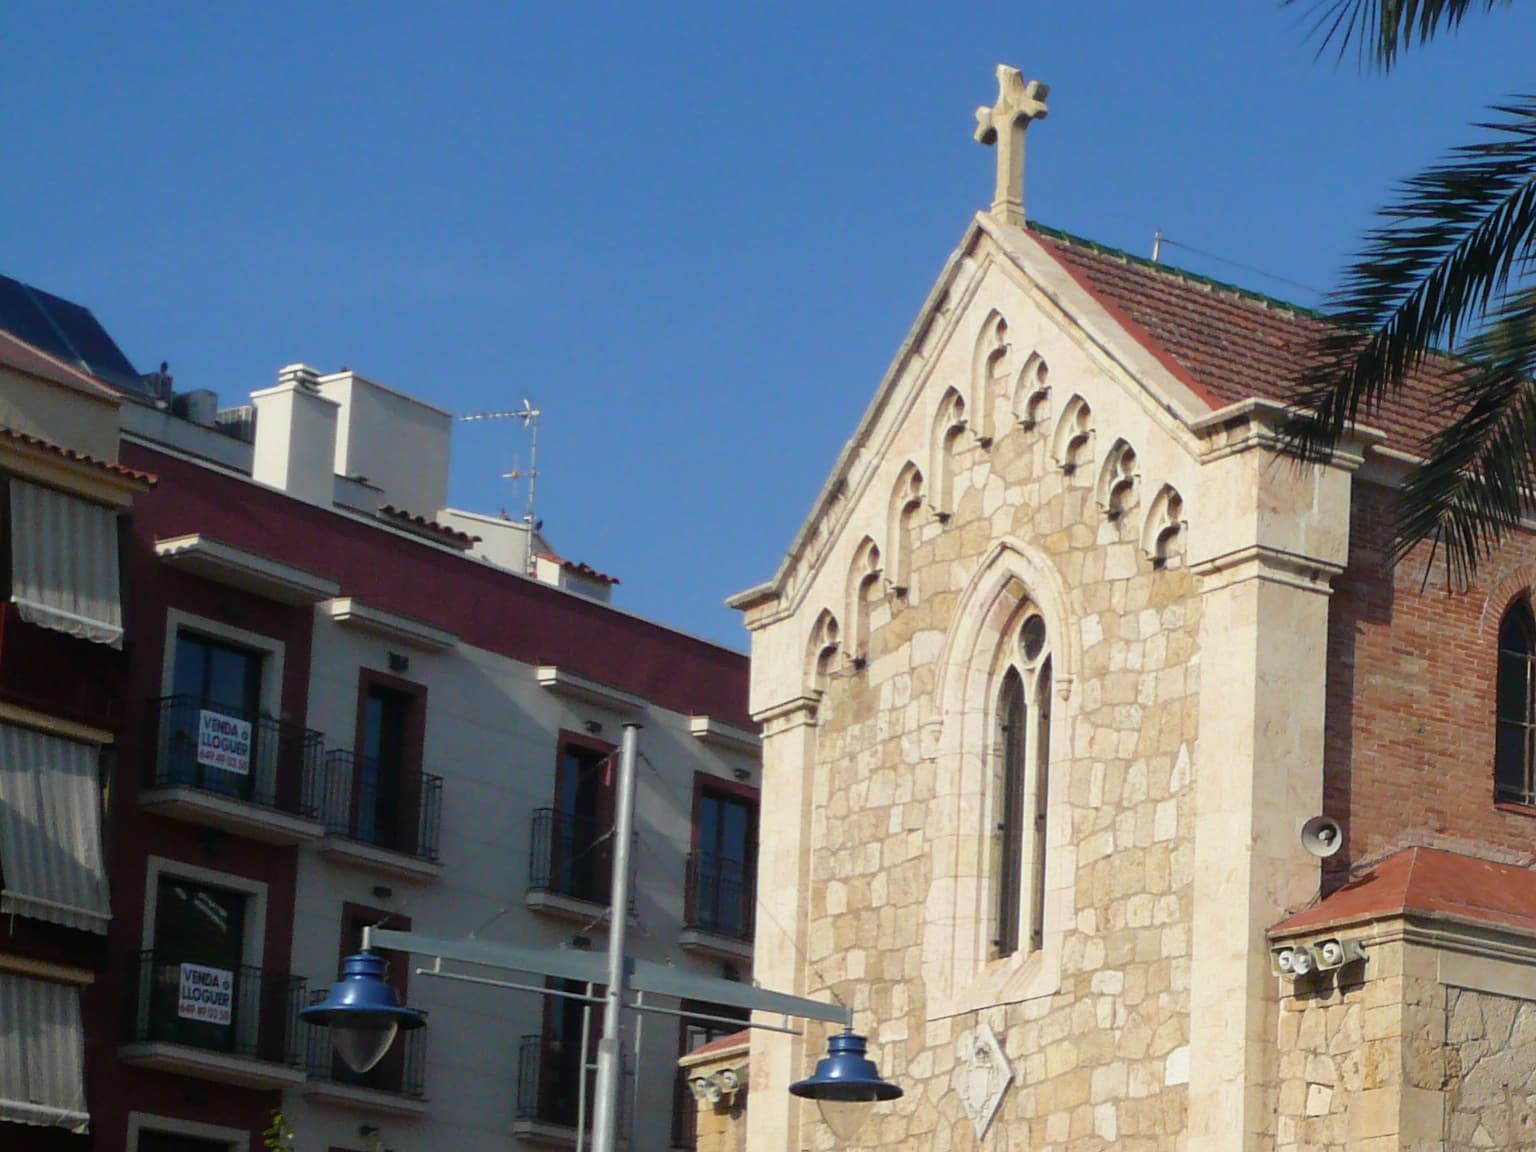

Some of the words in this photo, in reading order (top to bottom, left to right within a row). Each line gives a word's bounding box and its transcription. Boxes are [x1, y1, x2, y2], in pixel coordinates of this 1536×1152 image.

[203, 713, 238, 735] VENDA
[201, 732, 249, 755] LLOGUER
[183, 967, 219, 987] VENDA
[182, 984, 230, 1006] LLOGUER
